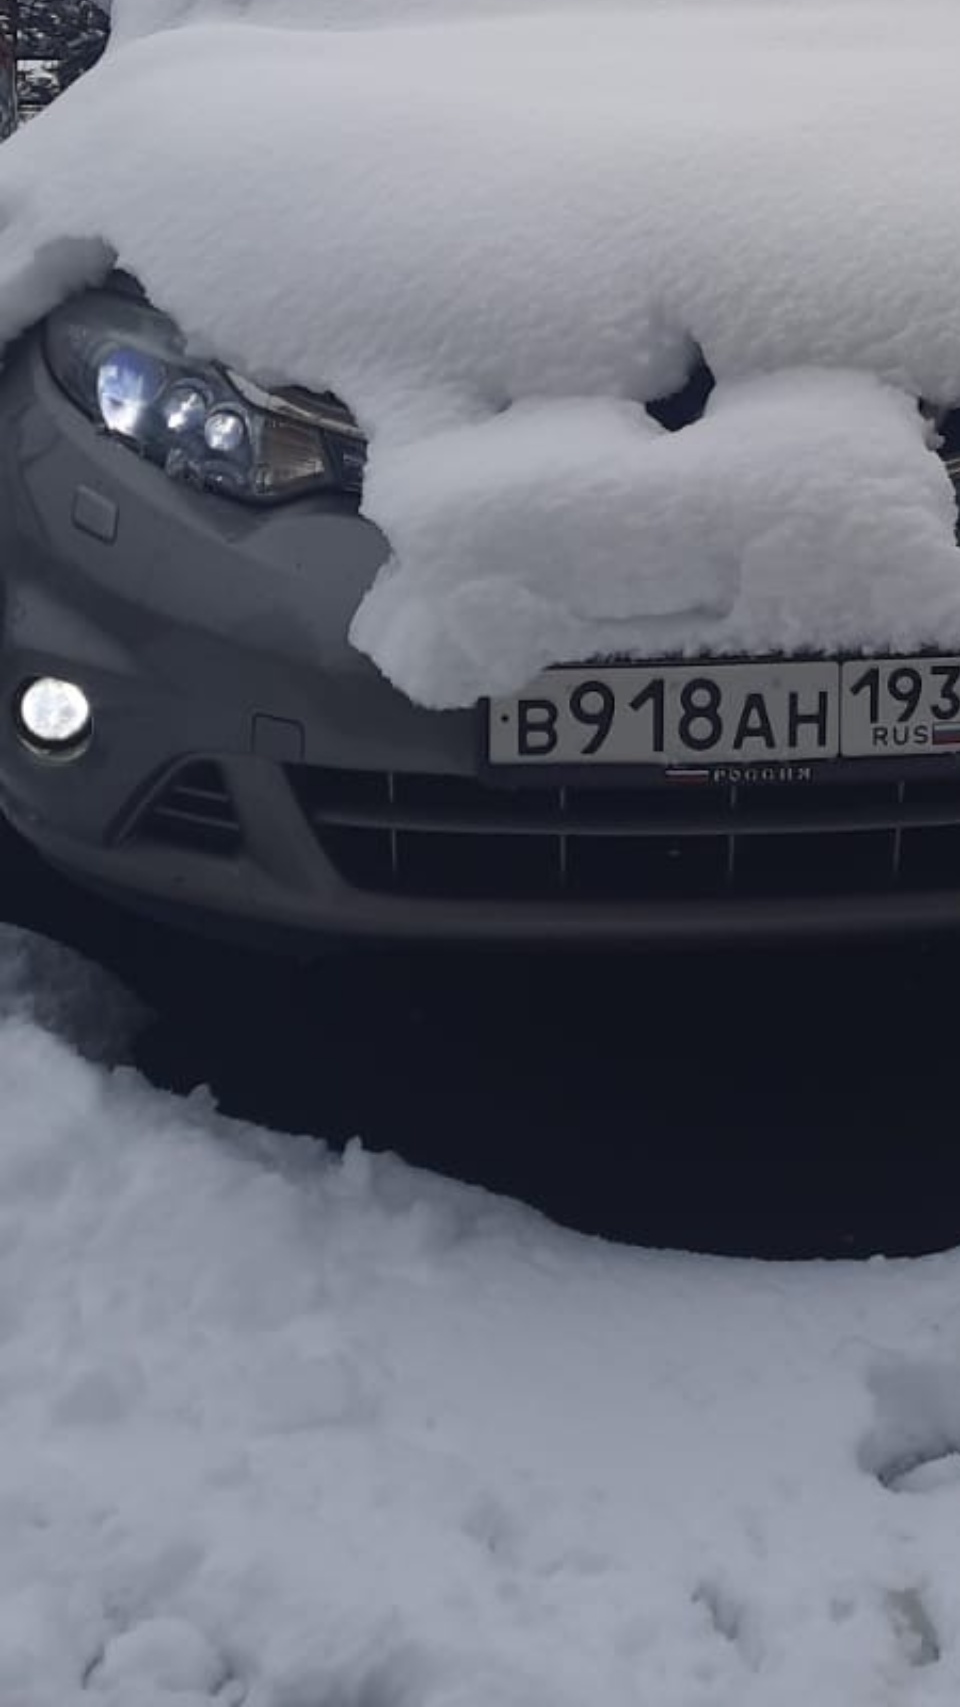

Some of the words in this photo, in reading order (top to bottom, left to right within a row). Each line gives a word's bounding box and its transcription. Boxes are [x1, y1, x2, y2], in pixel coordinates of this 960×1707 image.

[517, 678, 828, 756] В918АН
[850, 665, 960, 723] 193
[872, 725, 929, 747] RUS
